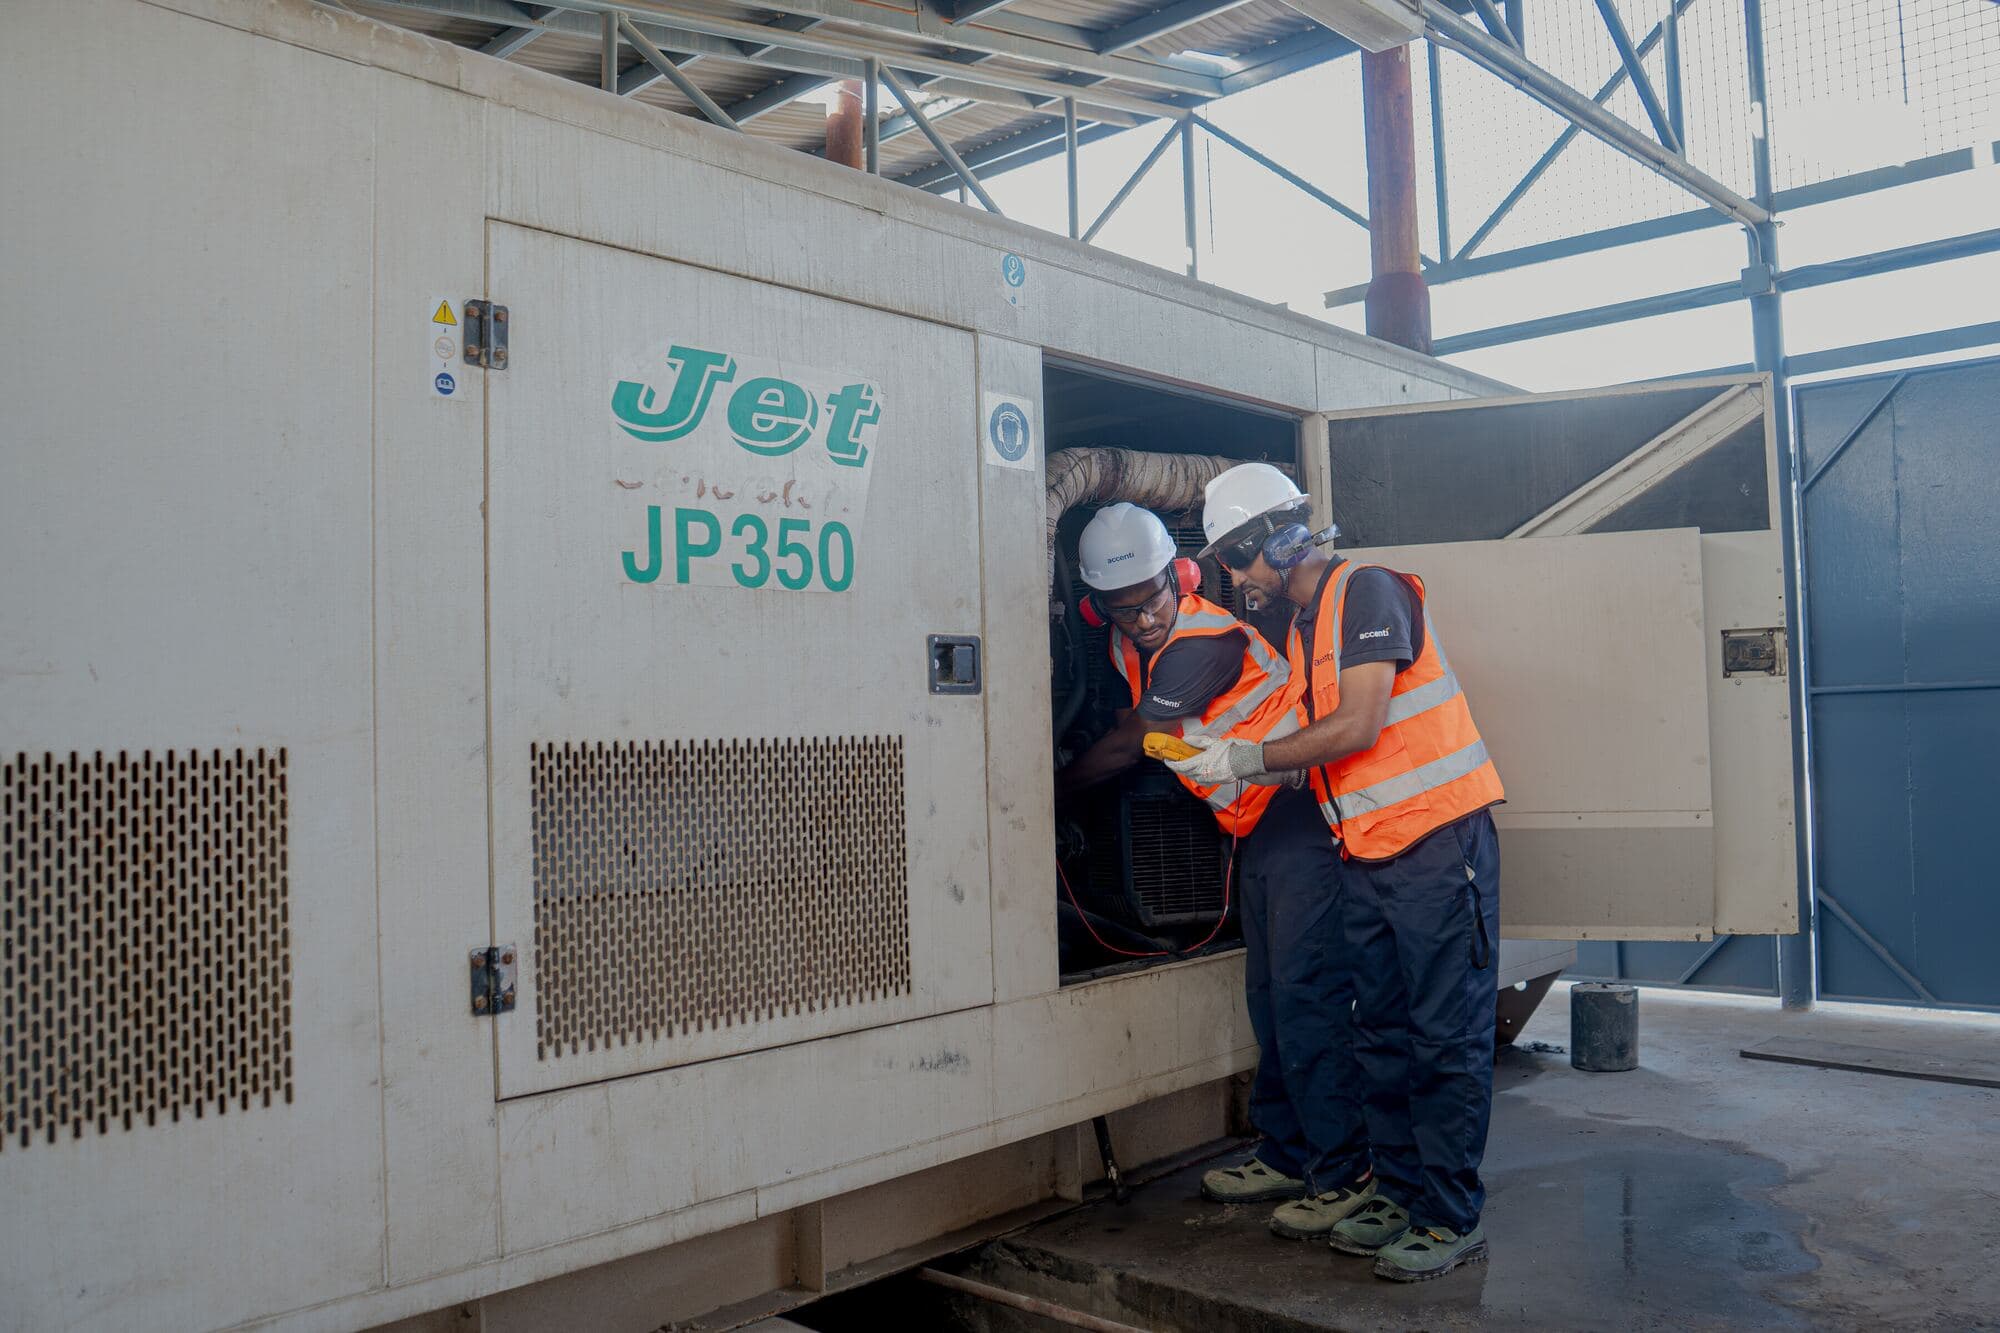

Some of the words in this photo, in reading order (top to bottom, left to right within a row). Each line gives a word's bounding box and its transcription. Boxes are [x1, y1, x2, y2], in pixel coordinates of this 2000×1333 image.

[611, 344, 881, 468] Jet
[621, 504, 855, 592] JP350
[1107, 551, 1135, 564] accenti
[1359, 626, 1390, 640] accenti
[1152, 695, 1183, 708] accenti
